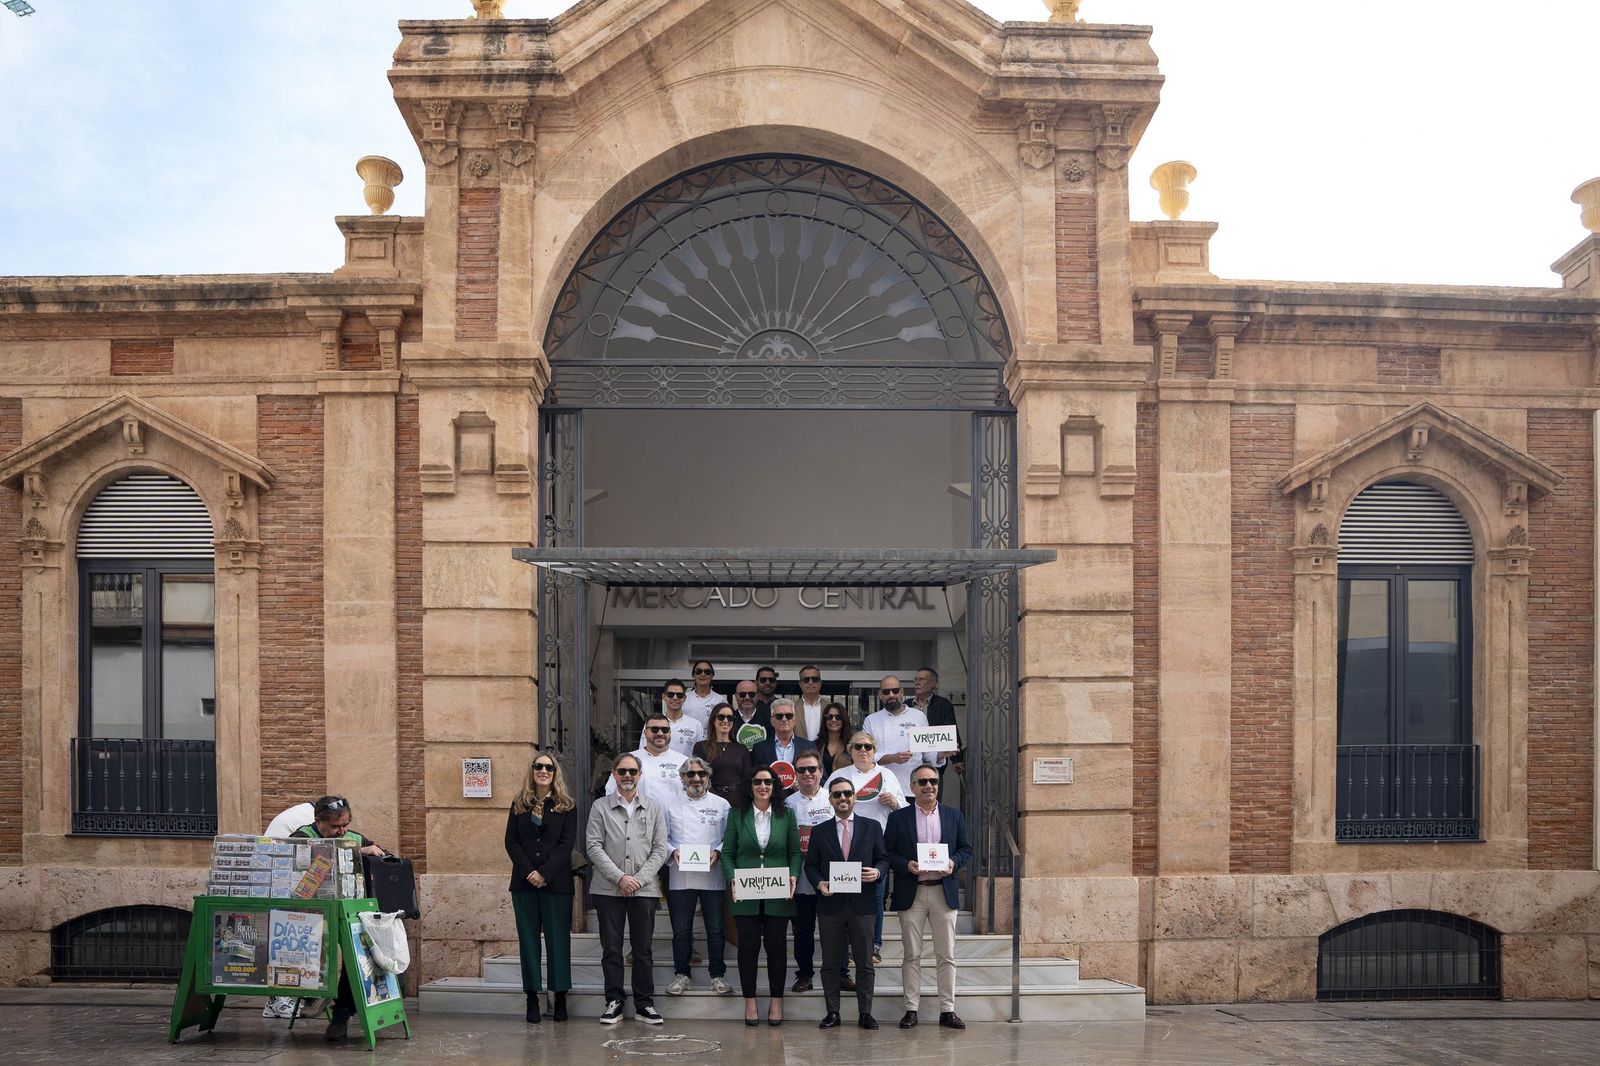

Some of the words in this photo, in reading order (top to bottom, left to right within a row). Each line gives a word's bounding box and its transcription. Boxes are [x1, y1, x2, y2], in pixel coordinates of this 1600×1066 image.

[612, 587, 778, 609] MERCADO
[274, 921, 297, 937] DÍA
[298, 925, 314, 935] DEL
[271, 935, 319, 960] PADRE
